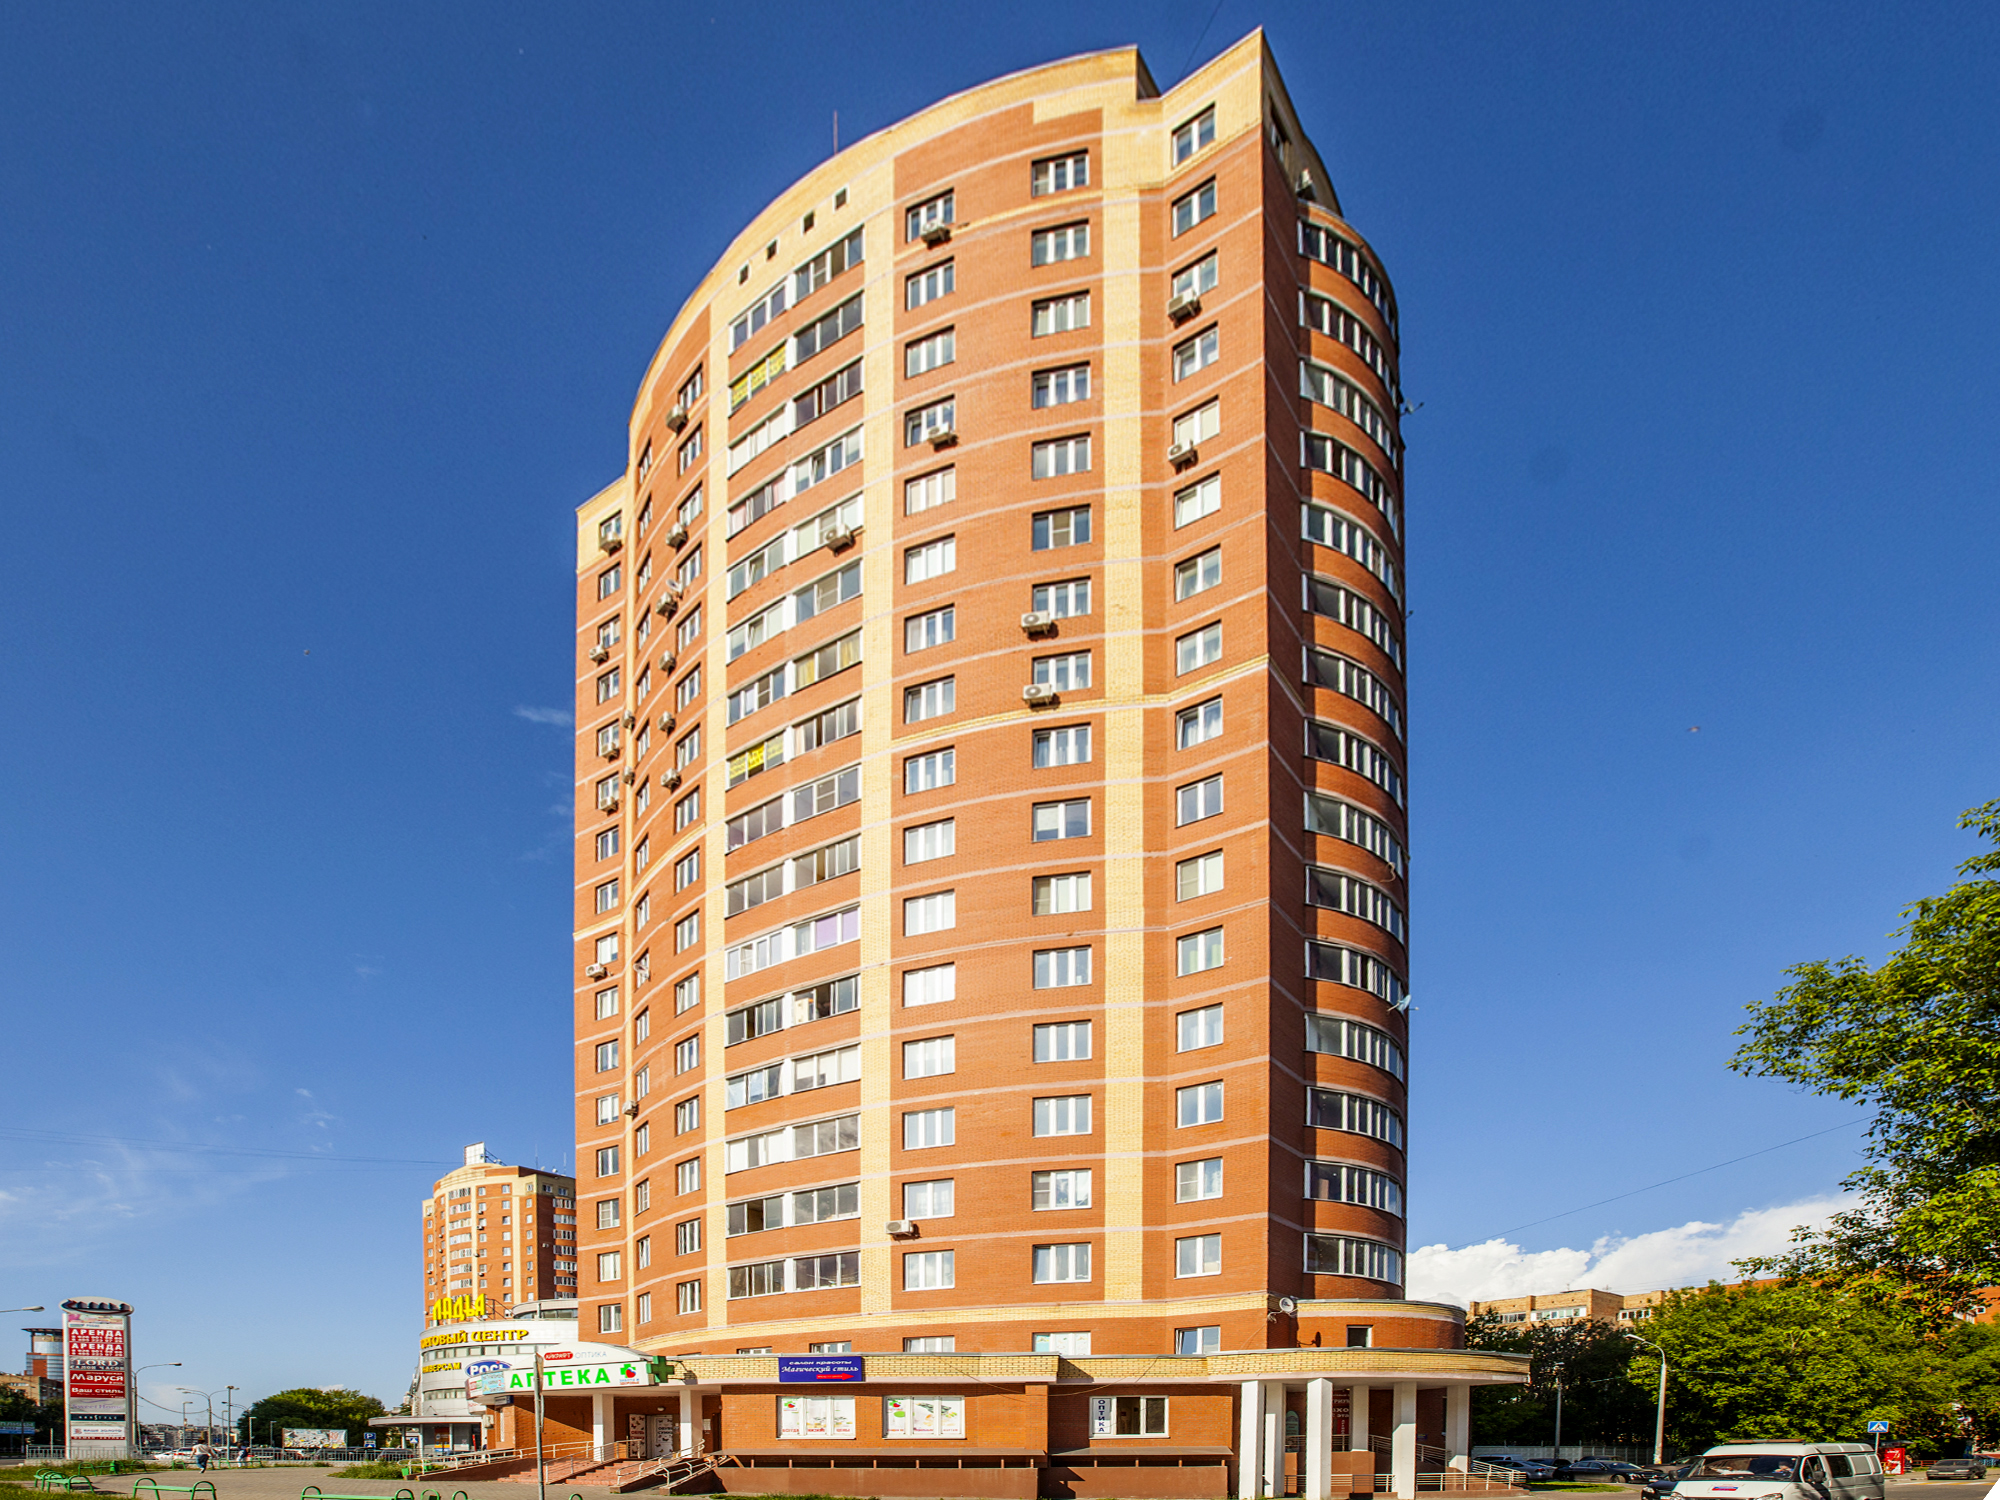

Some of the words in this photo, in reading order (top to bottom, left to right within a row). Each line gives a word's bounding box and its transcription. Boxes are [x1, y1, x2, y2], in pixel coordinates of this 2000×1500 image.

[433, 1293, 485, 1321] ЛАДЬЯ
[71, 1329, 122, 1337] АРЕНДА
[471, 1330, 529, 1342] ЦЕНТР
[71, 1343, 122, 1351] АРЕНДА
[575, 1351, 607, 1359] ОПТИКА
[71, 1373, 123, 1382] Маруся
[510, 1368, 610, 1388] АПТЕКА
[1098, 1400, 1106, 1432] ОПТИКА
